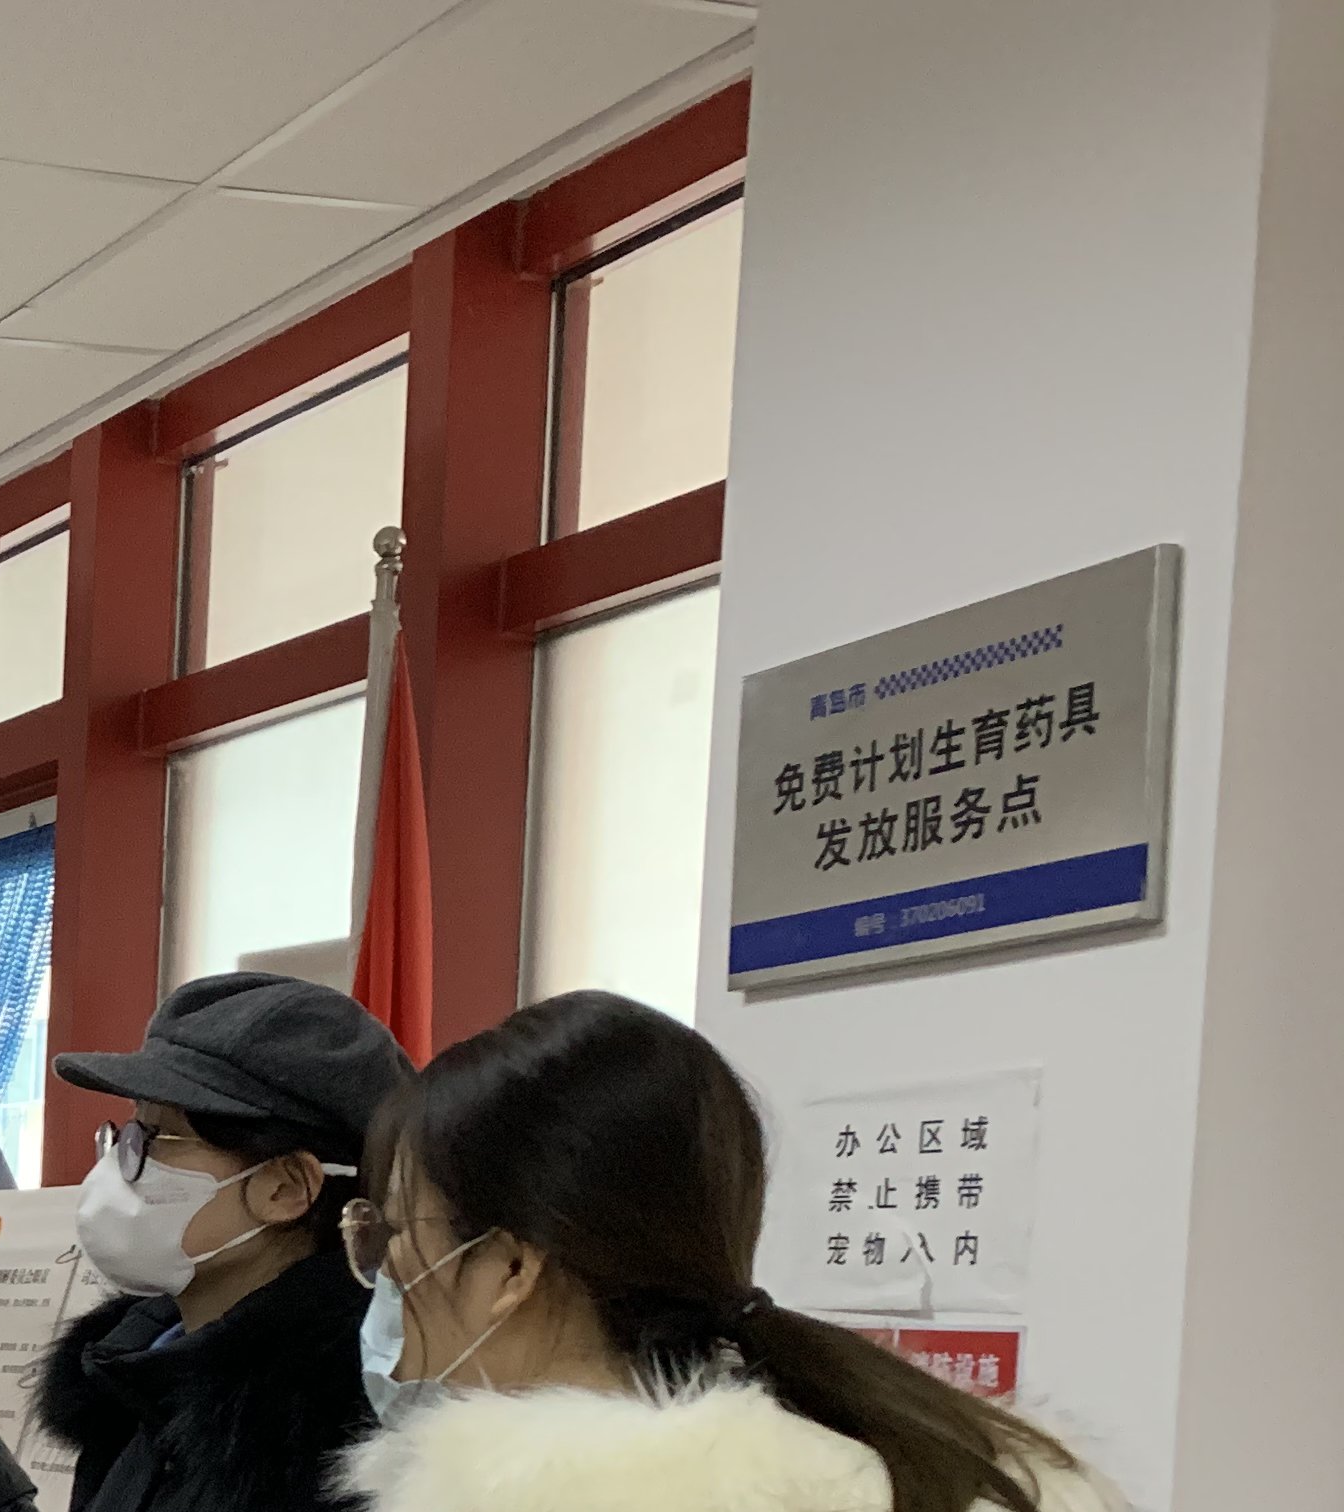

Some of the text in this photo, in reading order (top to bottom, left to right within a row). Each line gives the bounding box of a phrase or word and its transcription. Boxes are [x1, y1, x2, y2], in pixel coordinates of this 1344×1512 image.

[772, 681, 1101, 816] 免费计划生育药具
[814, 773, 1042, 872] 发放服务点
[835, 1115, 989, 1158] 办公区域
[828, 1173, 984, 1213] 禁止携带
